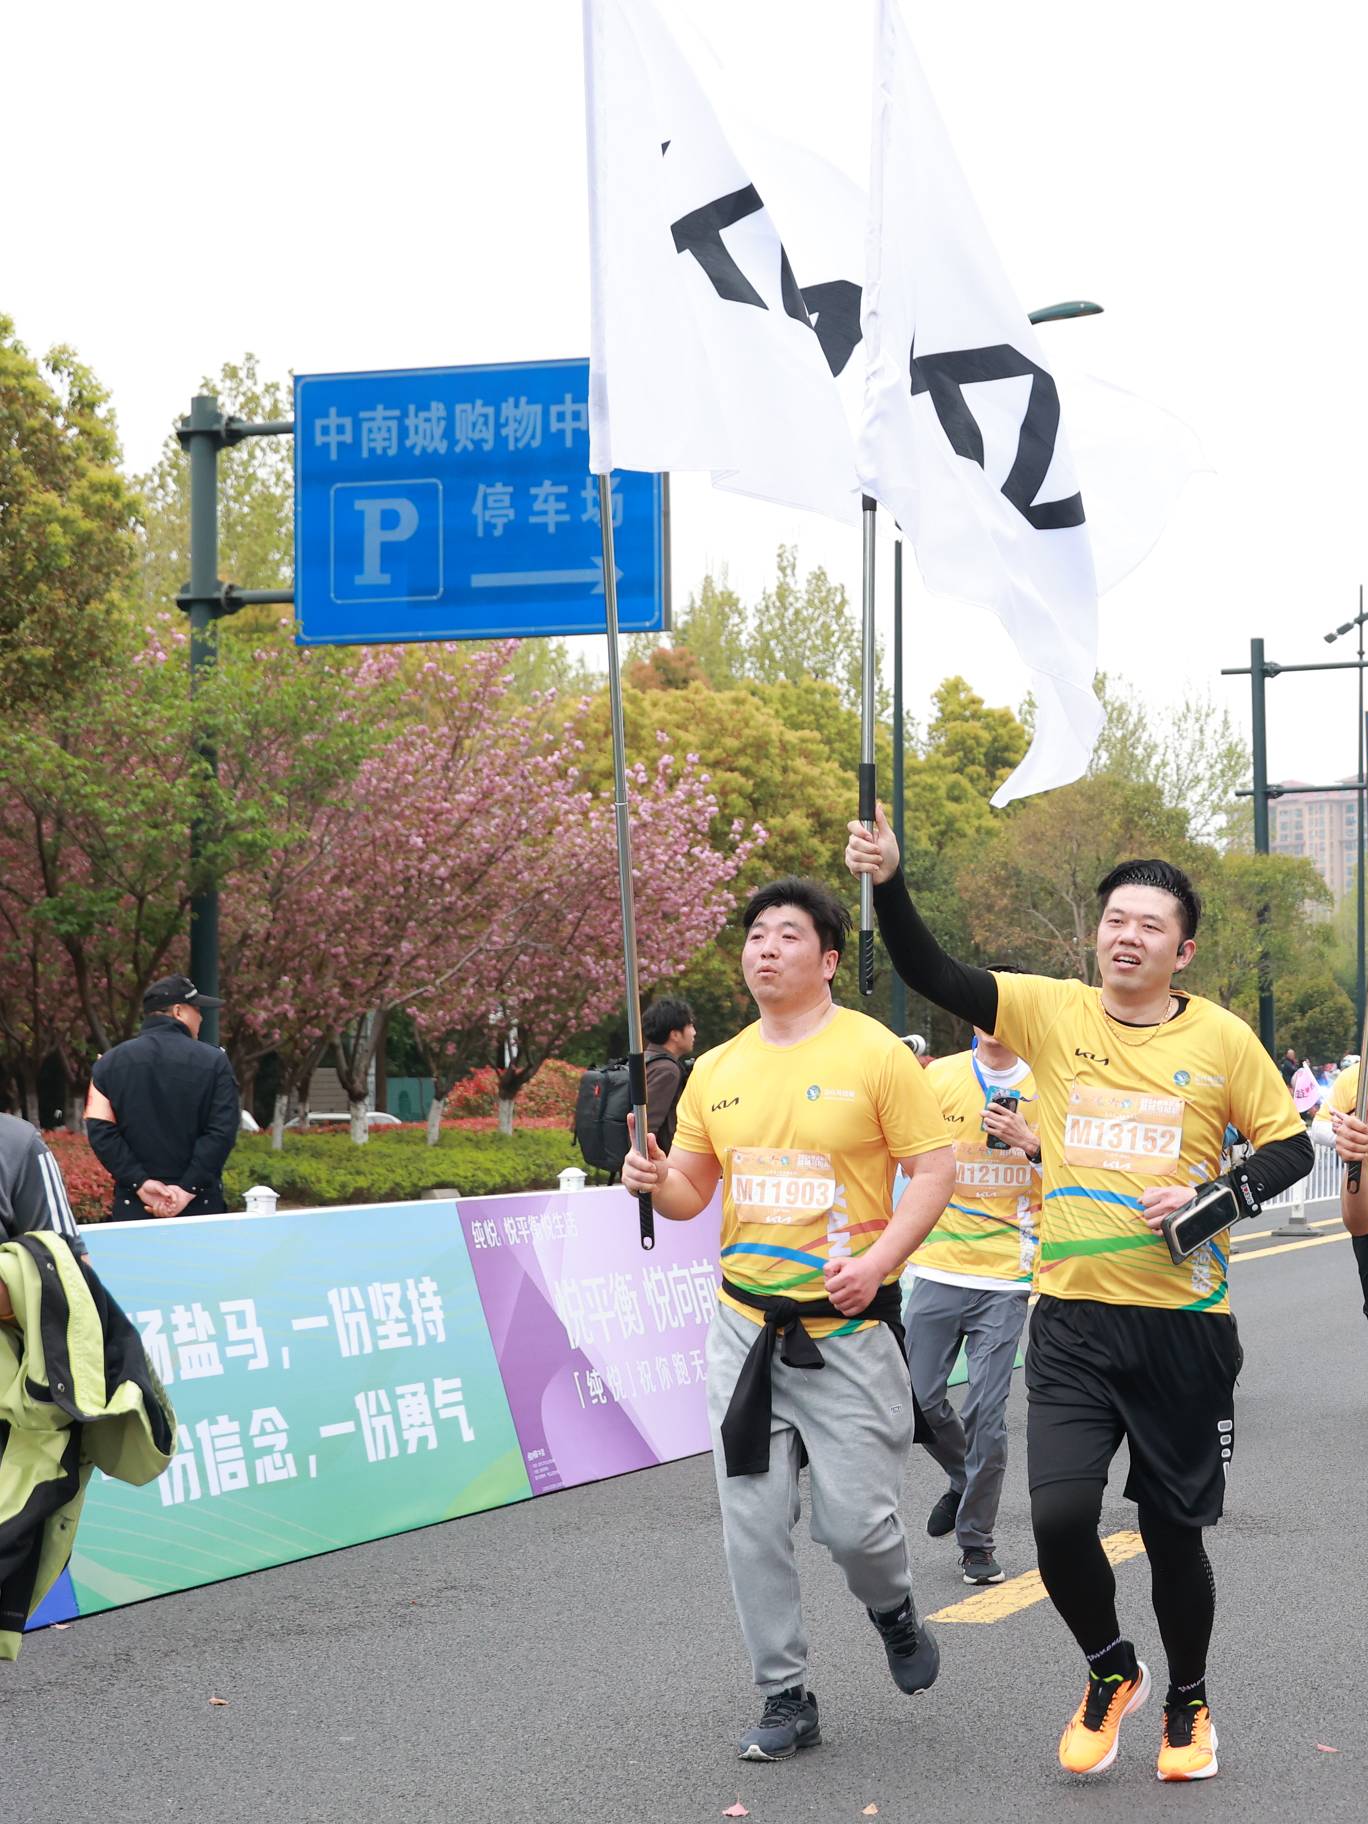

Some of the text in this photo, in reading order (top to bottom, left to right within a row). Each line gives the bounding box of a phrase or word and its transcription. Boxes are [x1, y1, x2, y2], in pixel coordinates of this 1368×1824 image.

[314, 392, 589, 461] 中南城购物中
[471, 476, 624, 538] 停车场
[353, 498, 419, 586] P
[1069, 1117, 1177, 1155] M13152
[735, 1177, 831, 1207] M11903
[101, 1376, 476, 1507] 份信念，一份勇气
